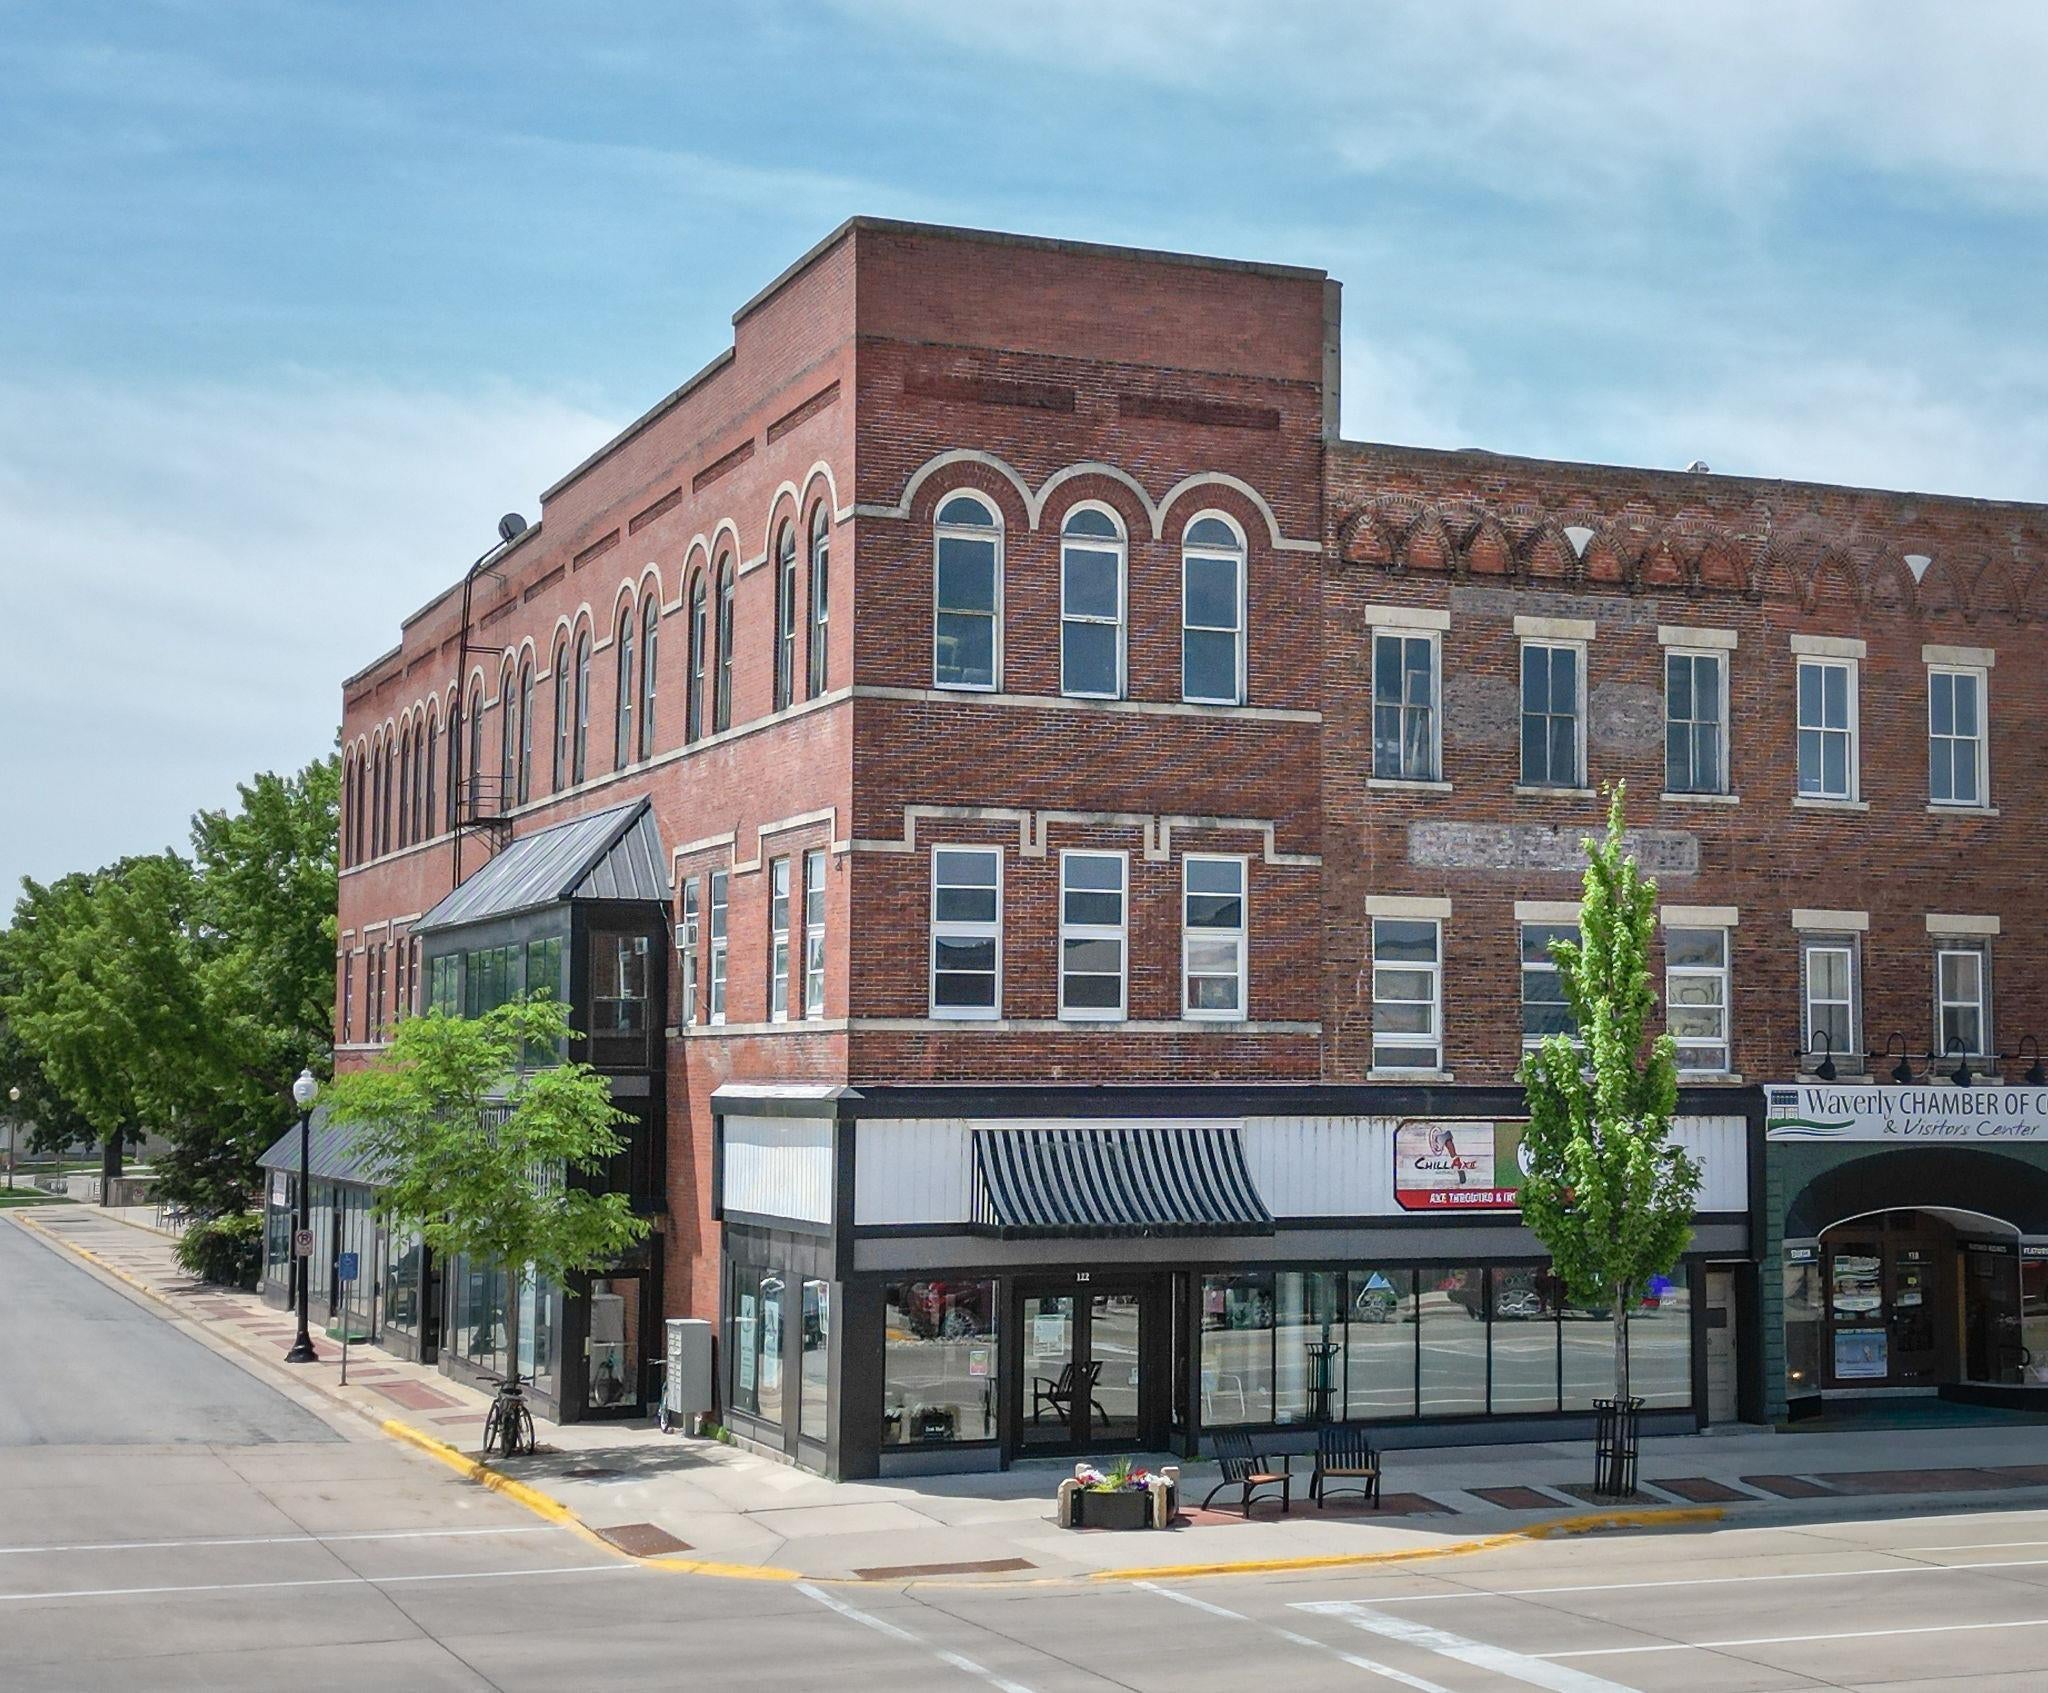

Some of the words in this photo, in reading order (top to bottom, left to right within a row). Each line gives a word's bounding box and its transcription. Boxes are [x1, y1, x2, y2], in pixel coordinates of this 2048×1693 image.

[1805, 1088, 1896, 1120] Waverly
[1900, 1092, 1998, 1115] CHAMBER
[2005, 1093, 2030, 1115] OF
[2036, 1093, 2048, 1115] C
[1883, 1119, 1898, 1134] &
[1904, 1117, 1970, 1136] Visitors
[1976, 1119, 2040, 1137] Center
[1076, 1272, 1090, 1281] 122
